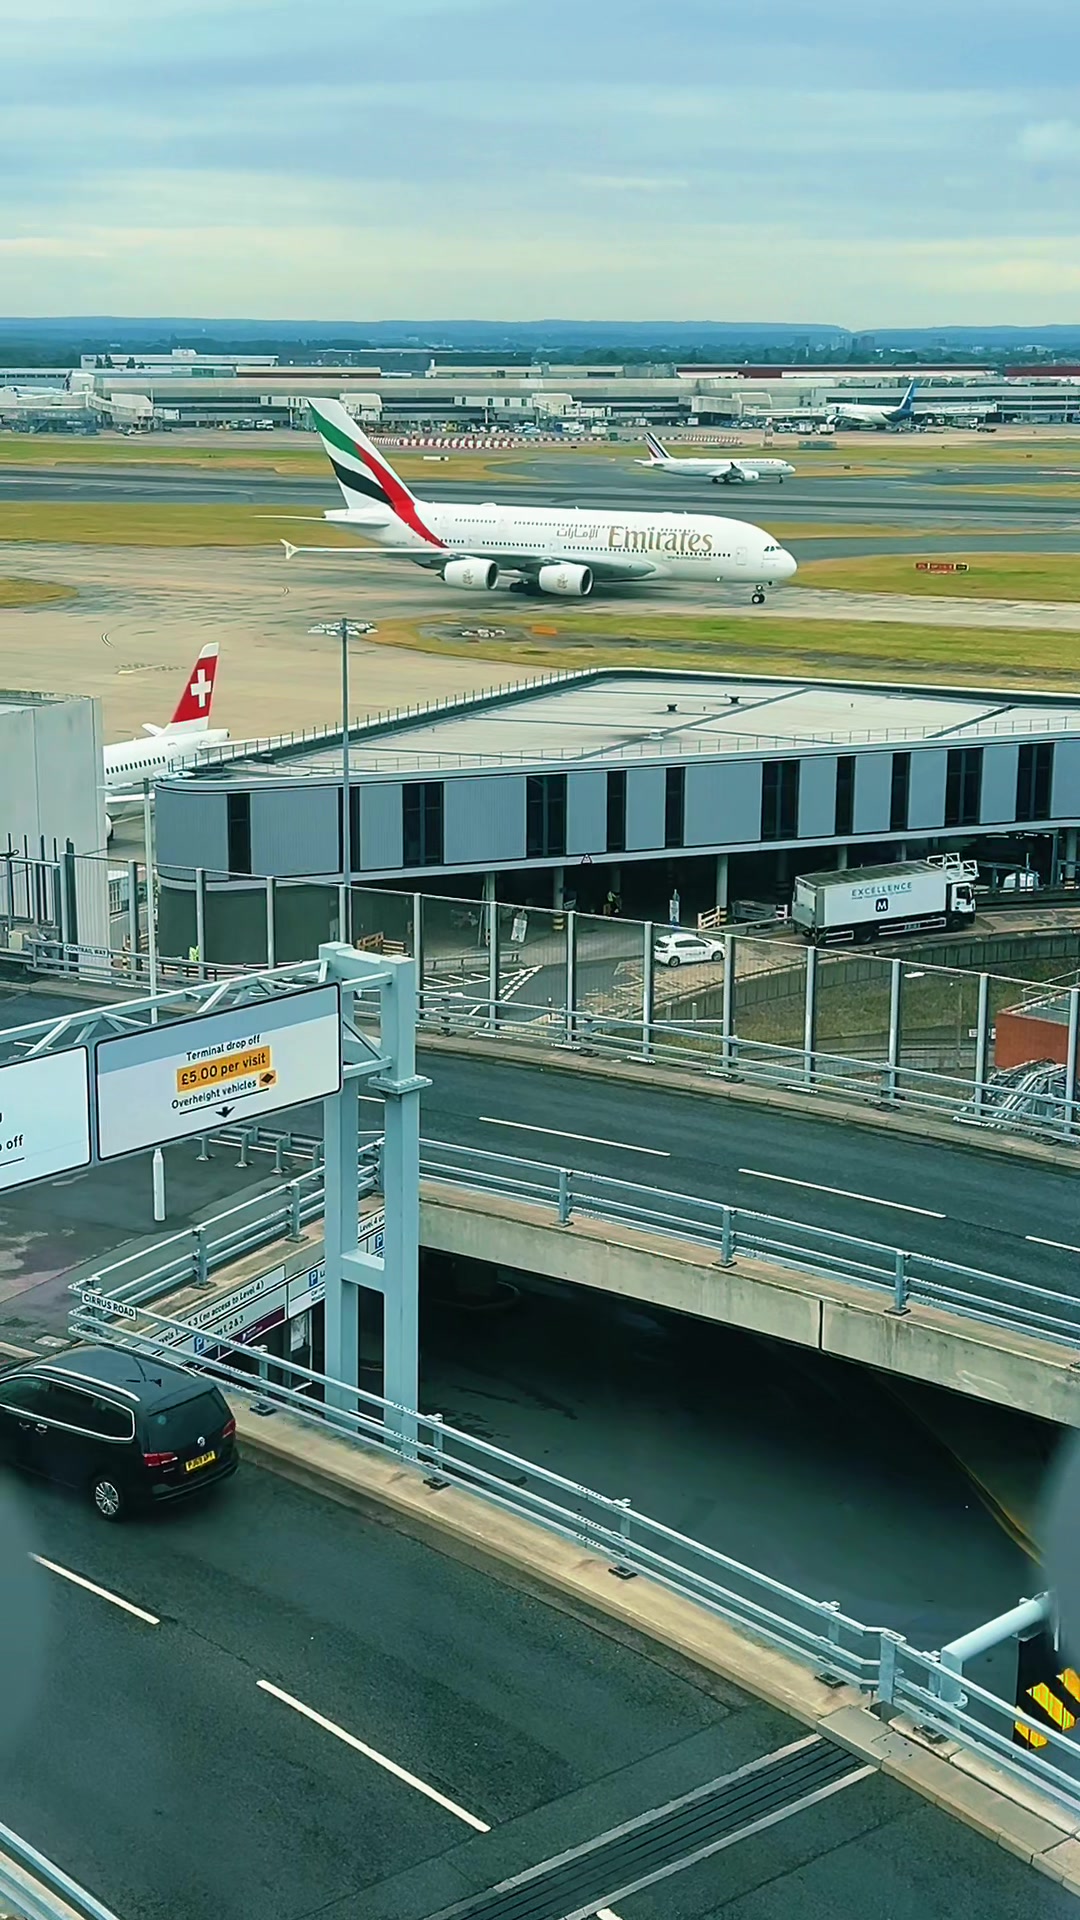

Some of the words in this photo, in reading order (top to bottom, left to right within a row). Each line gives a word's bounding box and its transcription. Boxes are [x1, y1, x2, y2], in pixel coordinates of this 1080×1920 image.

[608, 525, 713, 552] Emirates
[851, 882, 912, 897] EXCELLENCE
[876, 899, 888, 911] M
[186, 1044, 225, 1061] Terminal
[226, 1040, 246, 1051] drop
[248, 1034, 260, 1046] off
[181, 1065, 217, 1085] £5.00
[221, 1062, 240, 1077] per
[243, 1053, 266, 1068] visit
[171, 1089, 220, 1109] Overheight
[222, 1079, 257, 1095] vehicles
[6, 1134, 24, 1150] off
[83, 1294, 112, 1310] CIRRUS
[113, 1302, 135, 1317] ROAD
[211, 1301, 231, 1317] access
[231, 1297, 239, 1306] to
[239, 1288, 255, 1301] Level
